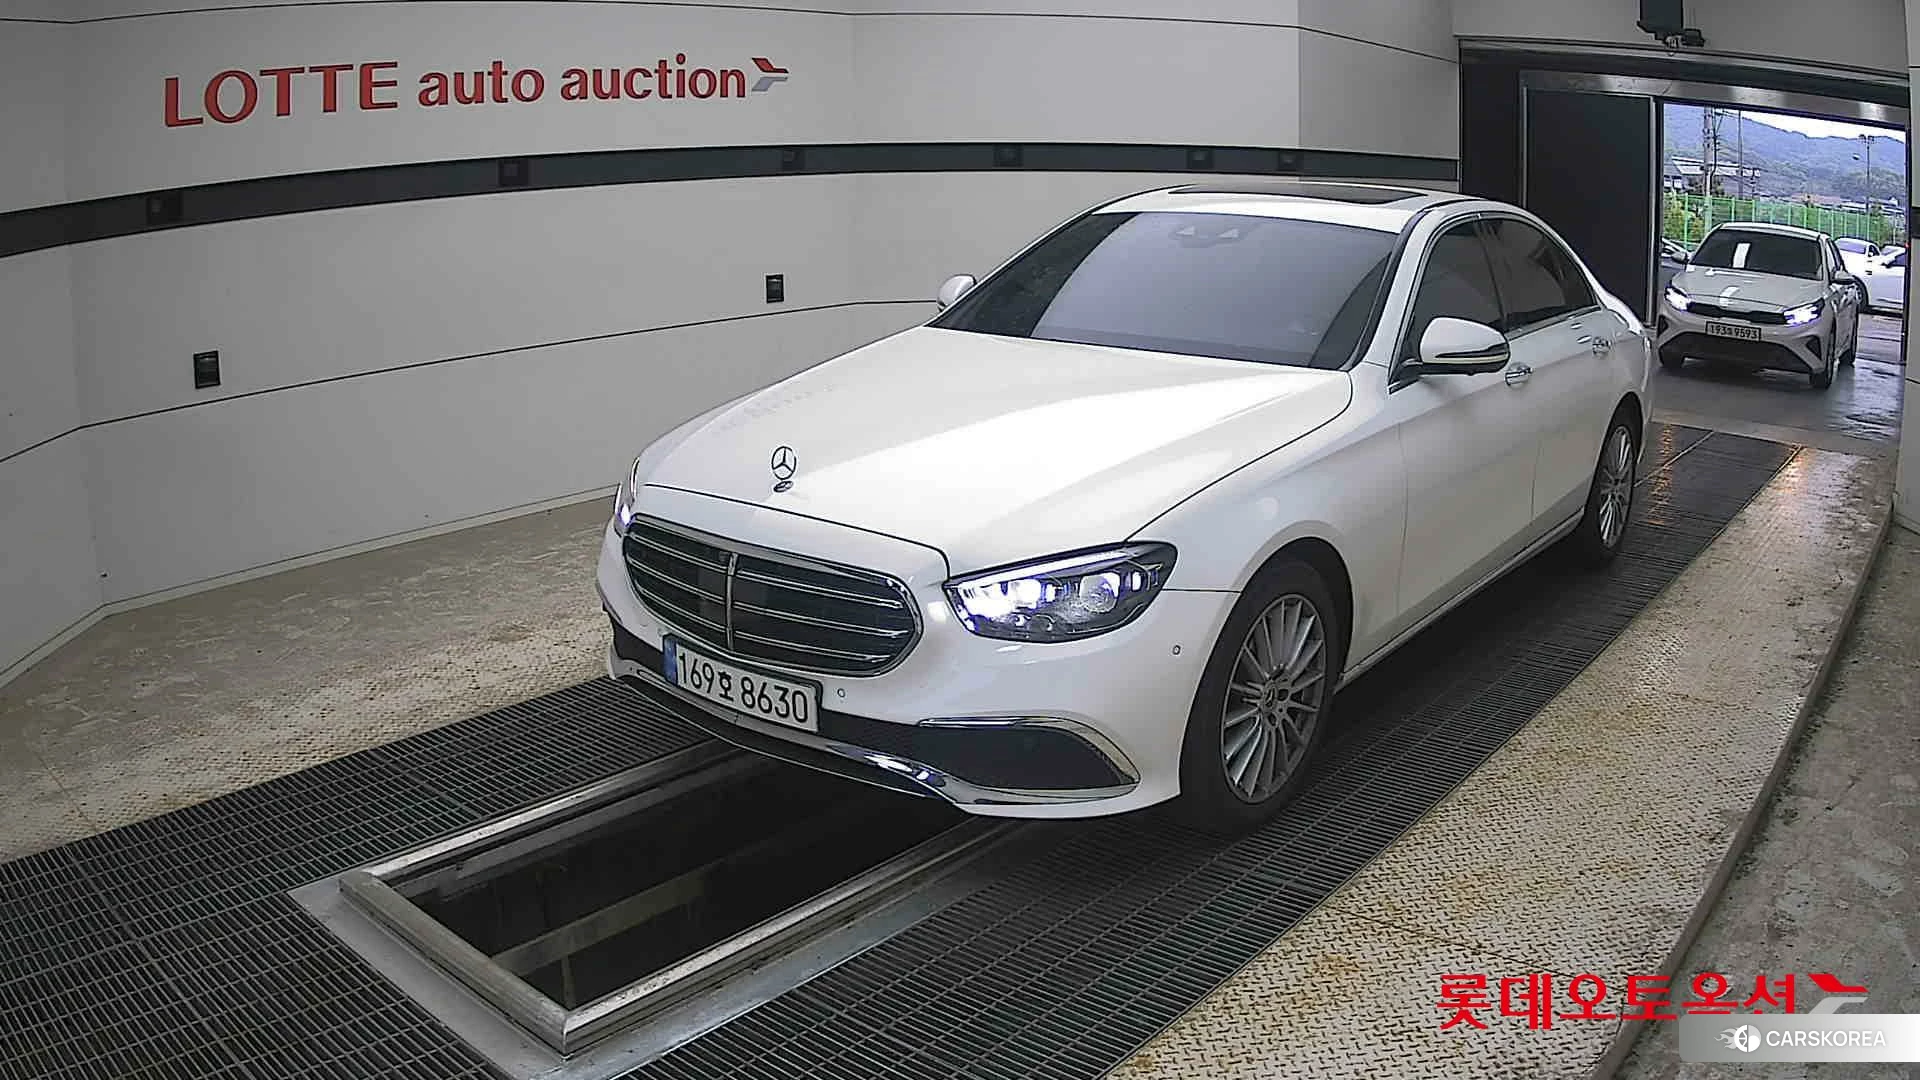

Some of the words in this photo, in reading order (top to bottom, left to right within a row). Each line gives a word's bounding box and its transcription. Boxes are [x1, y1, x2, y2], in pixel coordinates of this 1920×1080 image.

[164, 62, 399, 128] LOTTE
[417, 61, 545, 107] auto
[560, 53, 748, 101] auction
[741, 677, 808, 723] 8630
